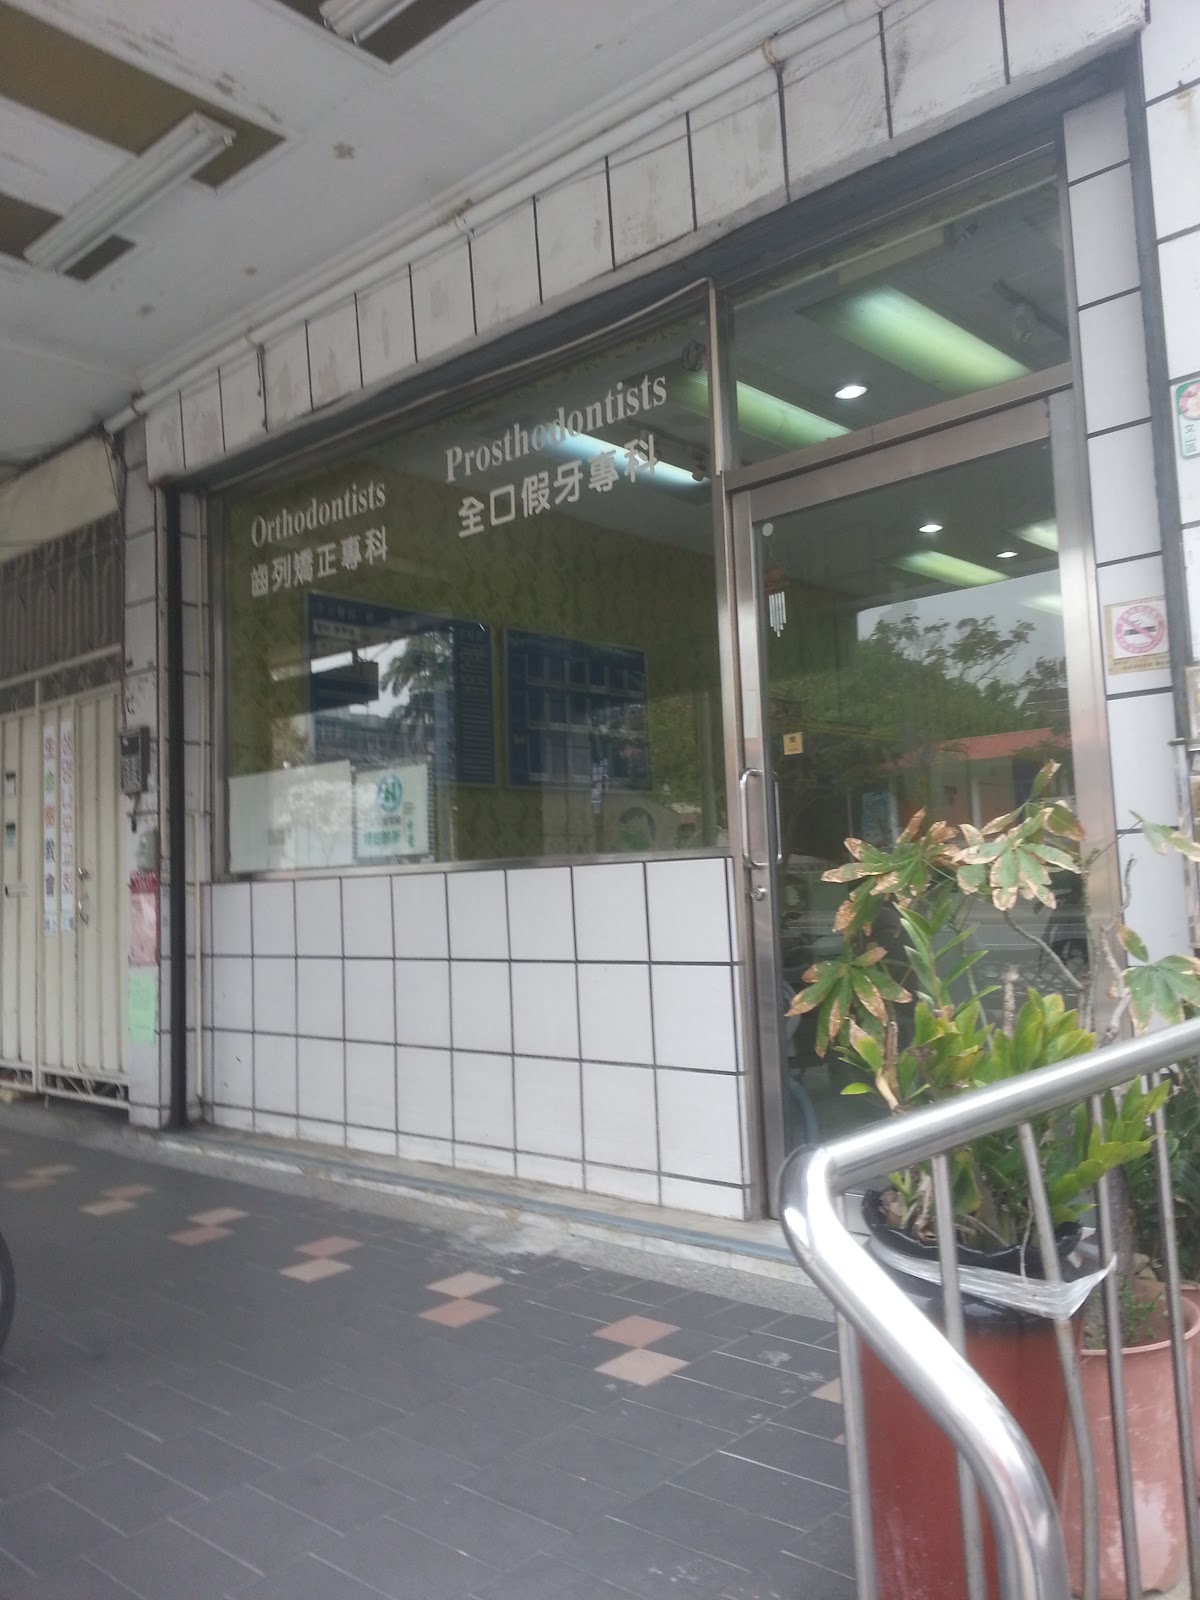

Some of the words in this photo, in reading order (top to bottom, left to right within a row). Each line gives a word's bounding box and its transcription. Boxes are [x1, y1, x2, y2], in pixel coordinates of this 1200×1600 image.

[446, 374, 667, 483] Prosthodontists
[251, 480, 386, 548] Orthodontists
[458, 433, 658, 539] 全口假牙專科
